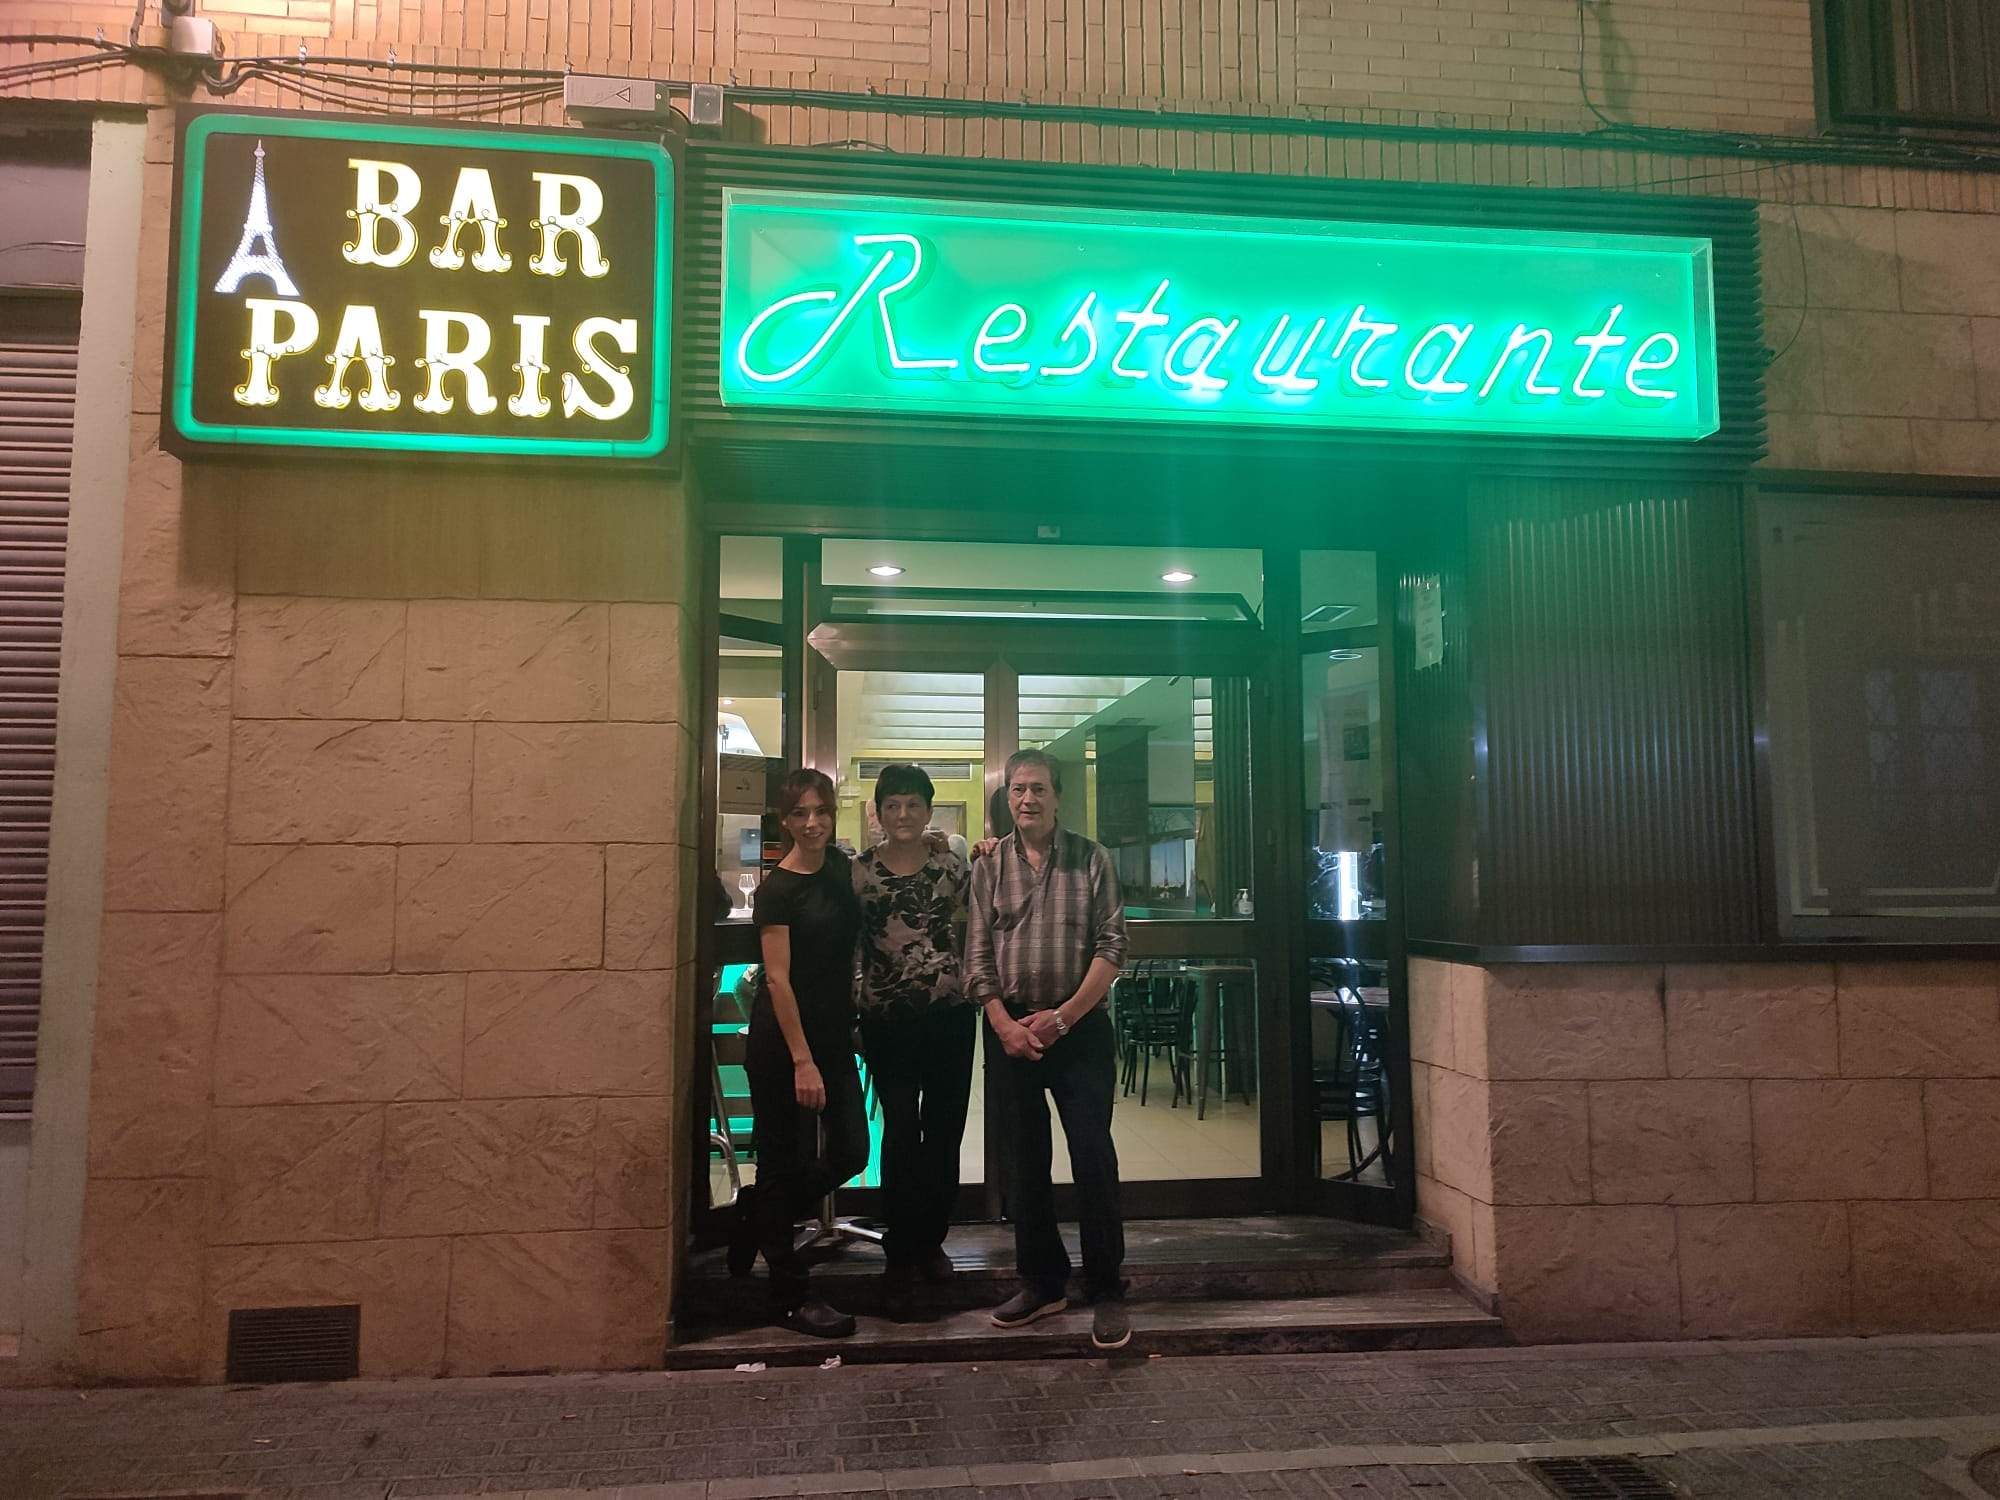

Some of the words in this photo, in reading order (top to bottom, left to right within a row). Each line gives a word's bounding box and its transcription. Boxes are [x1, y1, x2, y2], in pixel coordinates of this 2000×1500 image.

[342, 158, 610, 279] BAR
[233, 298, 638, 421] PARIS
[738, 233, 1680, 400] Restaurante
